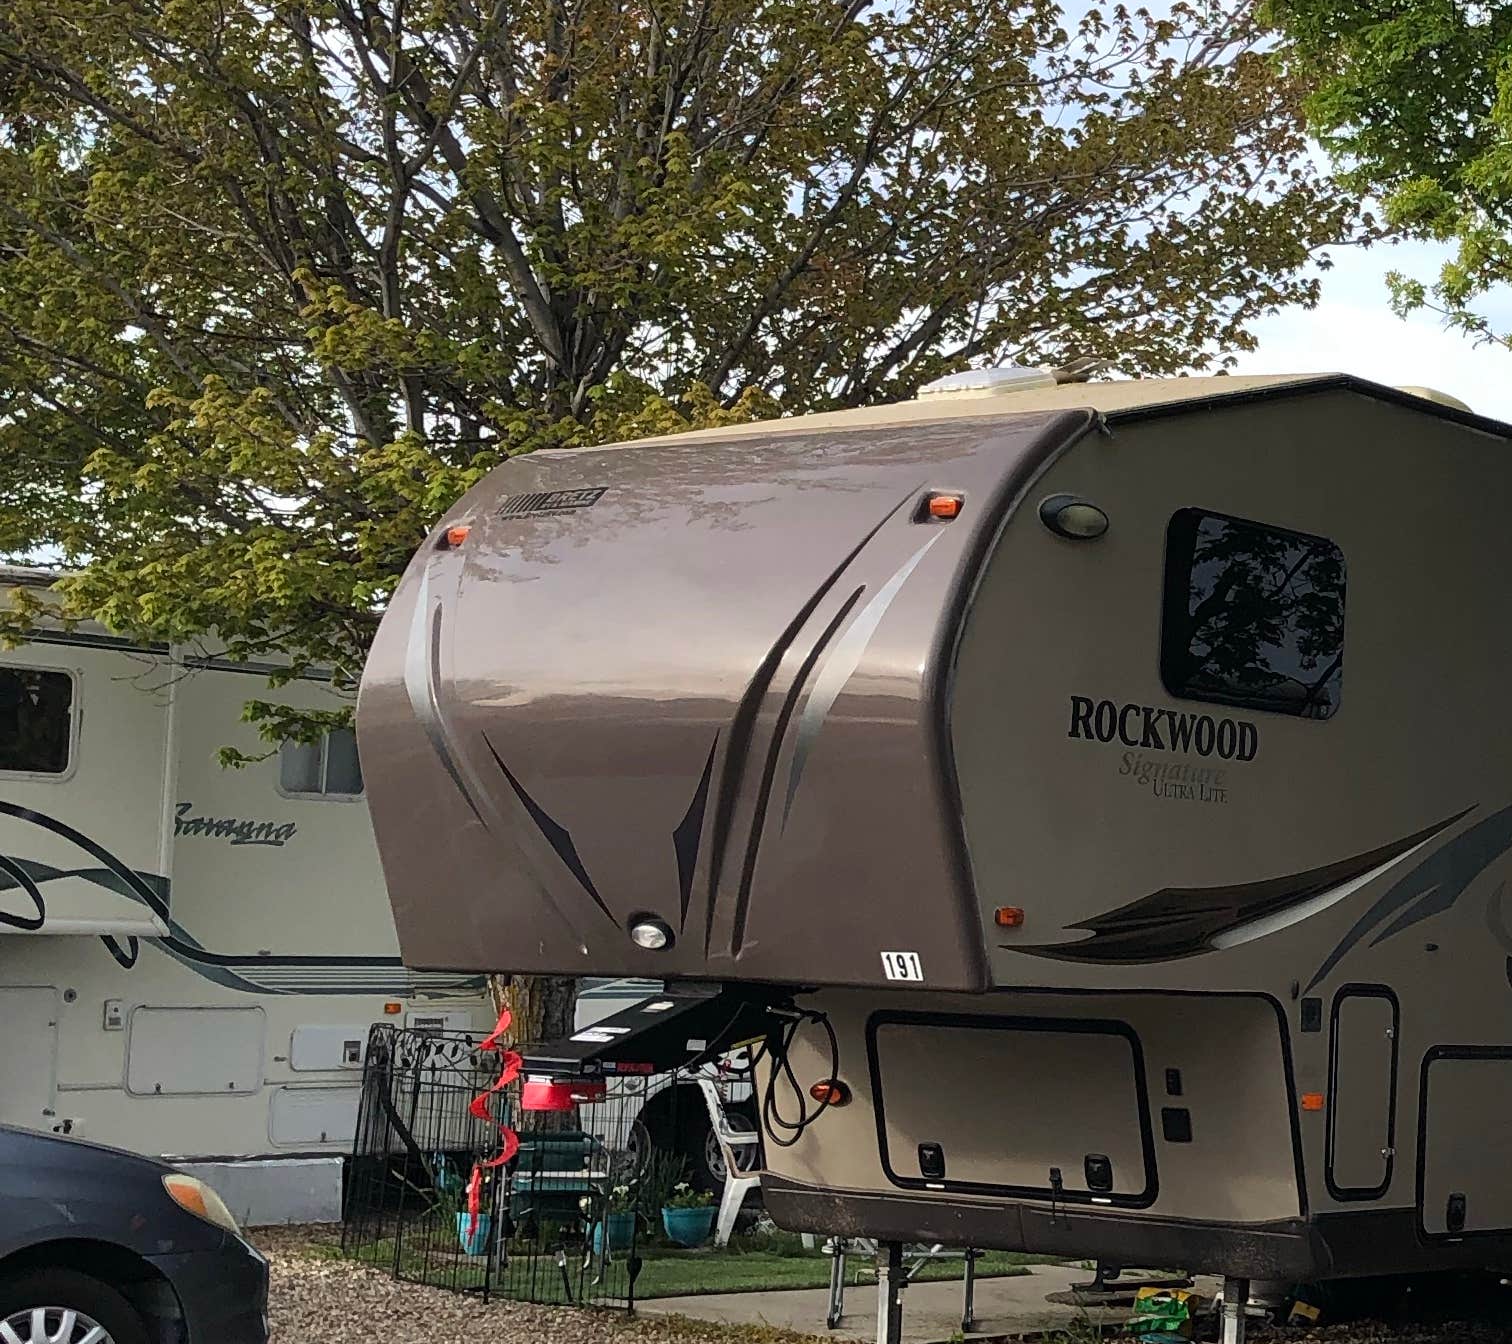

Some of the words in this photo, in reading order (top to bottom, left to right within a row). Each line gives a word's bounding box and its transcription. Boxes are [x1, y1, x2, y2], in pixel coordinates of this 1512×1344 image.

[1068, 695, 1258, 762] ROCKWOOD
[1118, 751, 1227, 785] Signature
[886, 953, 919, 979] 191
